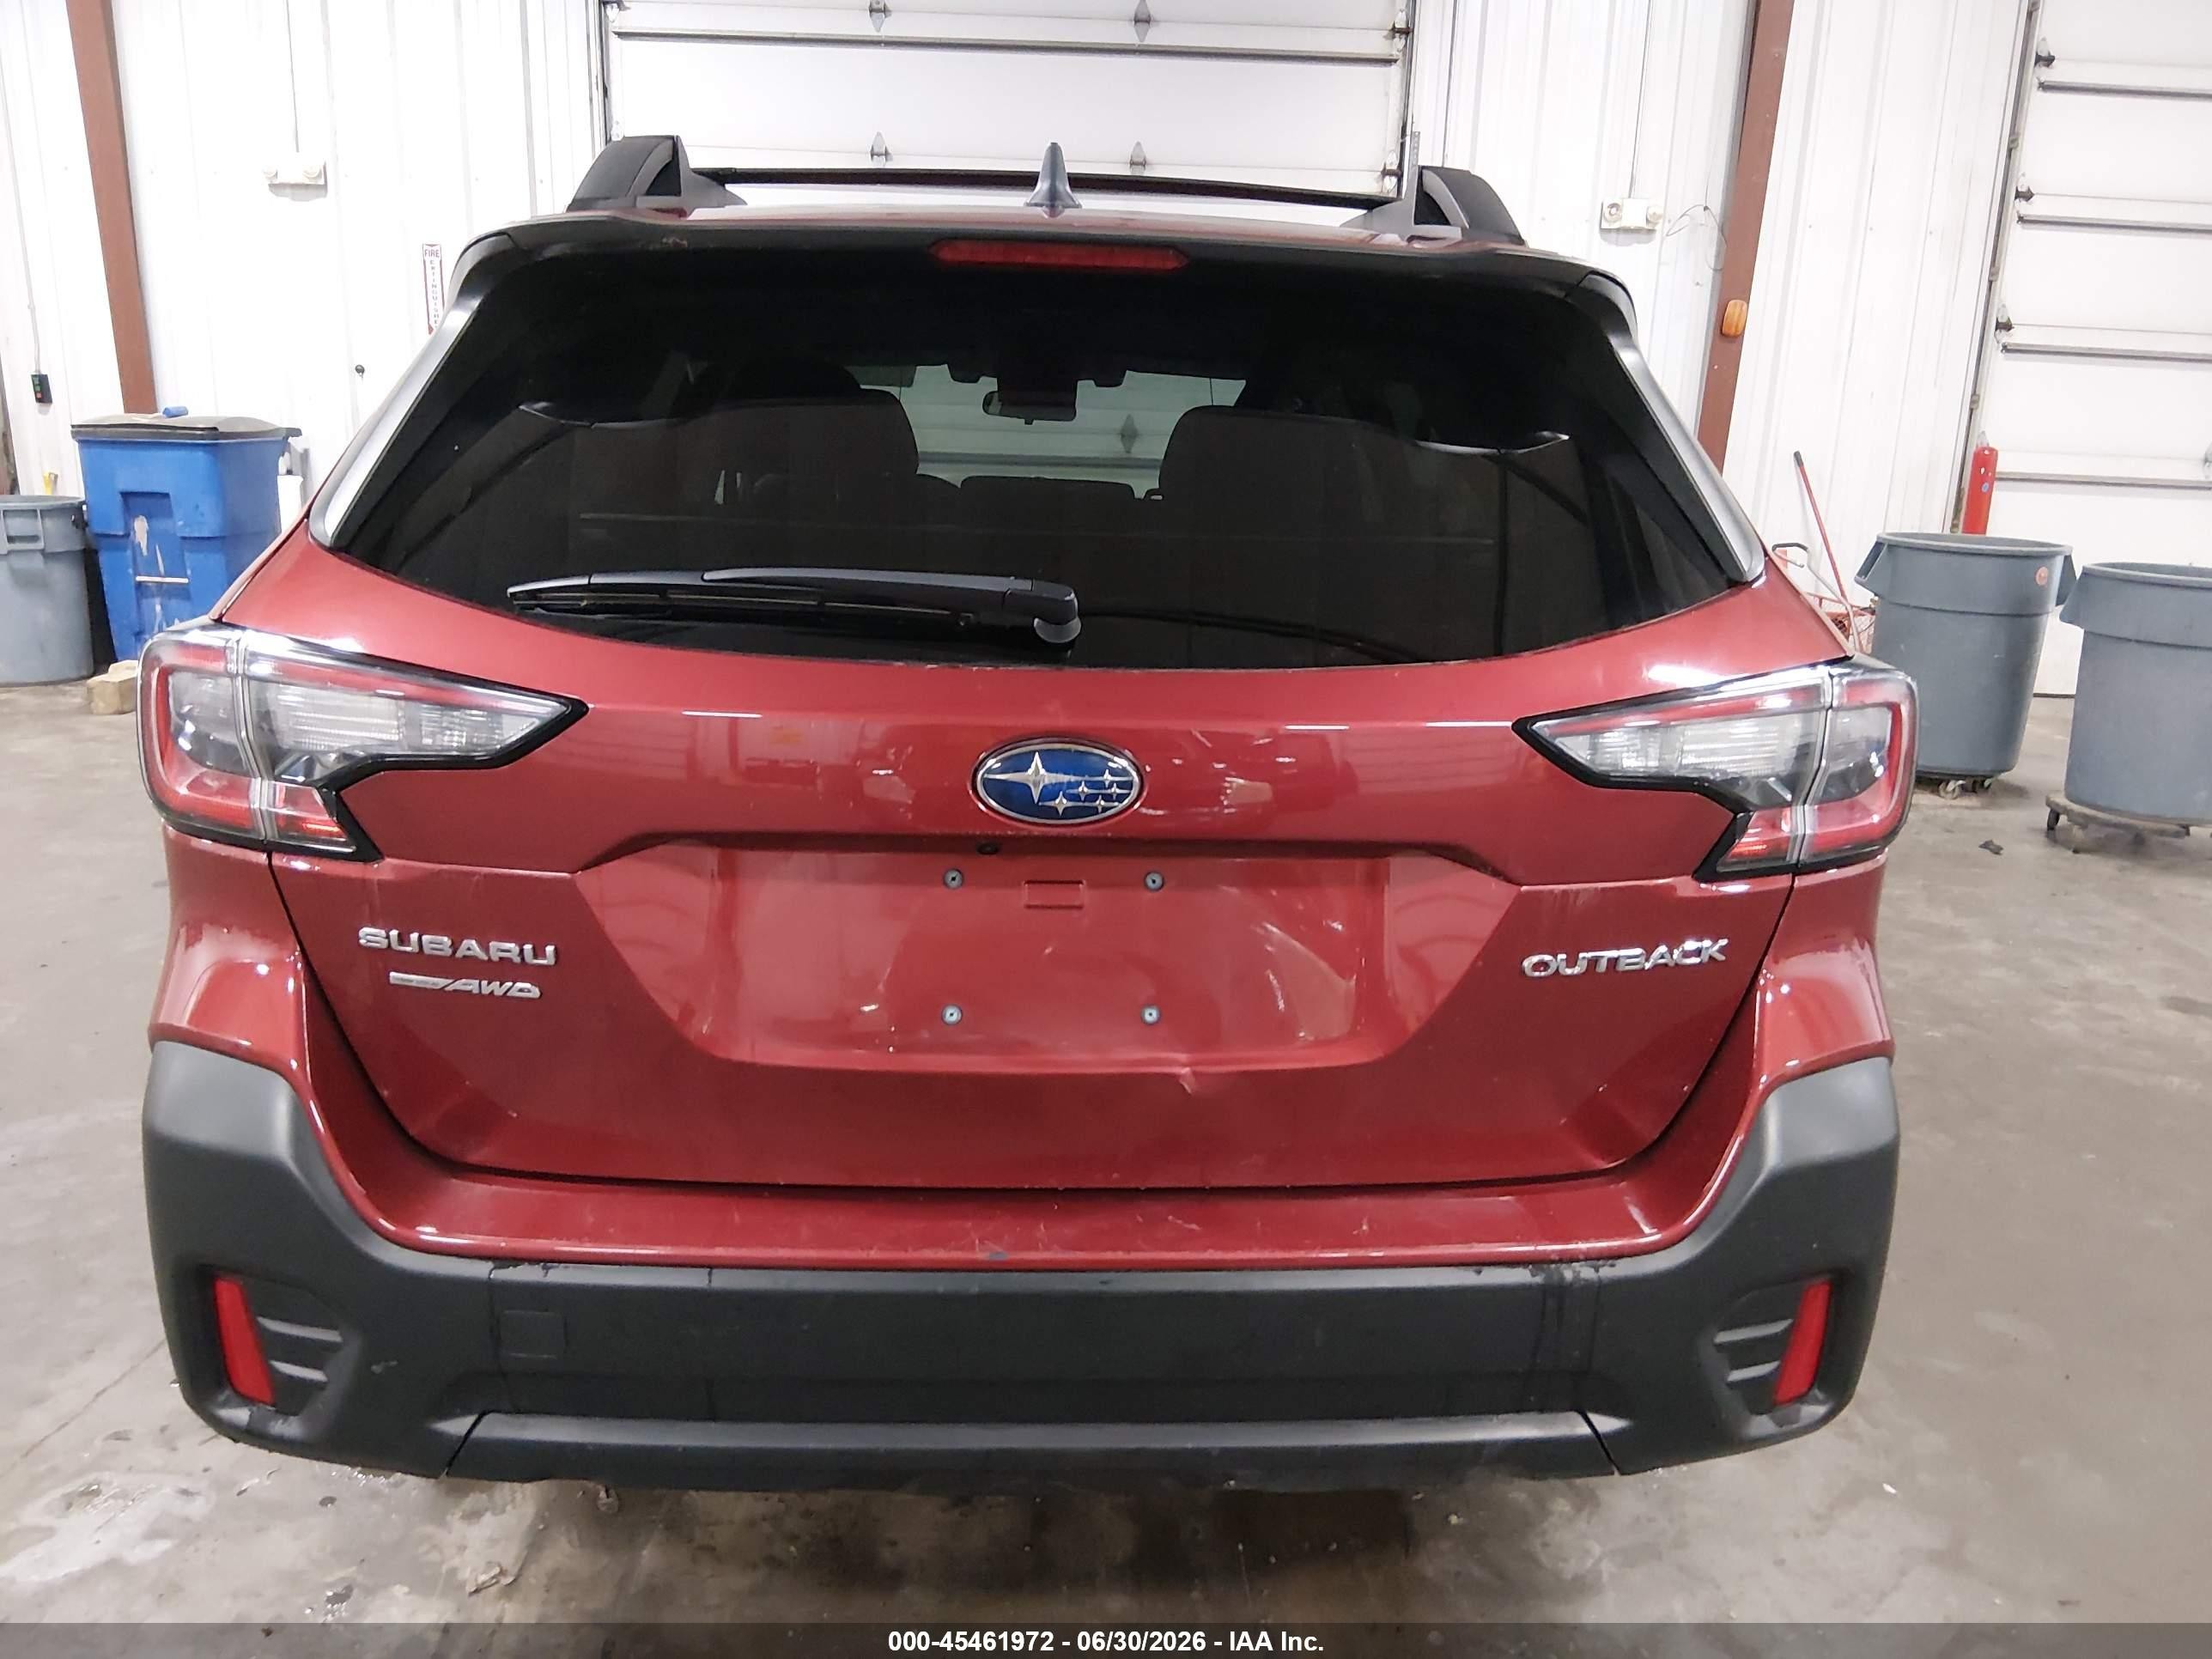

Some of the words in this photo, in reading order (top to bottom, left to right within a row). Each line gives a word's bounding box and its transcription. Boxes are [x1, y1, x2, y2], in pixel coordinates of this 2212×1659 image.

[424, 249, 440, 258] FIRE
[359, 927, 556, 966] SUBARU
[1522, 938, 1729, 977] OUTBACK
[444, 978, 542, 999] AWD
